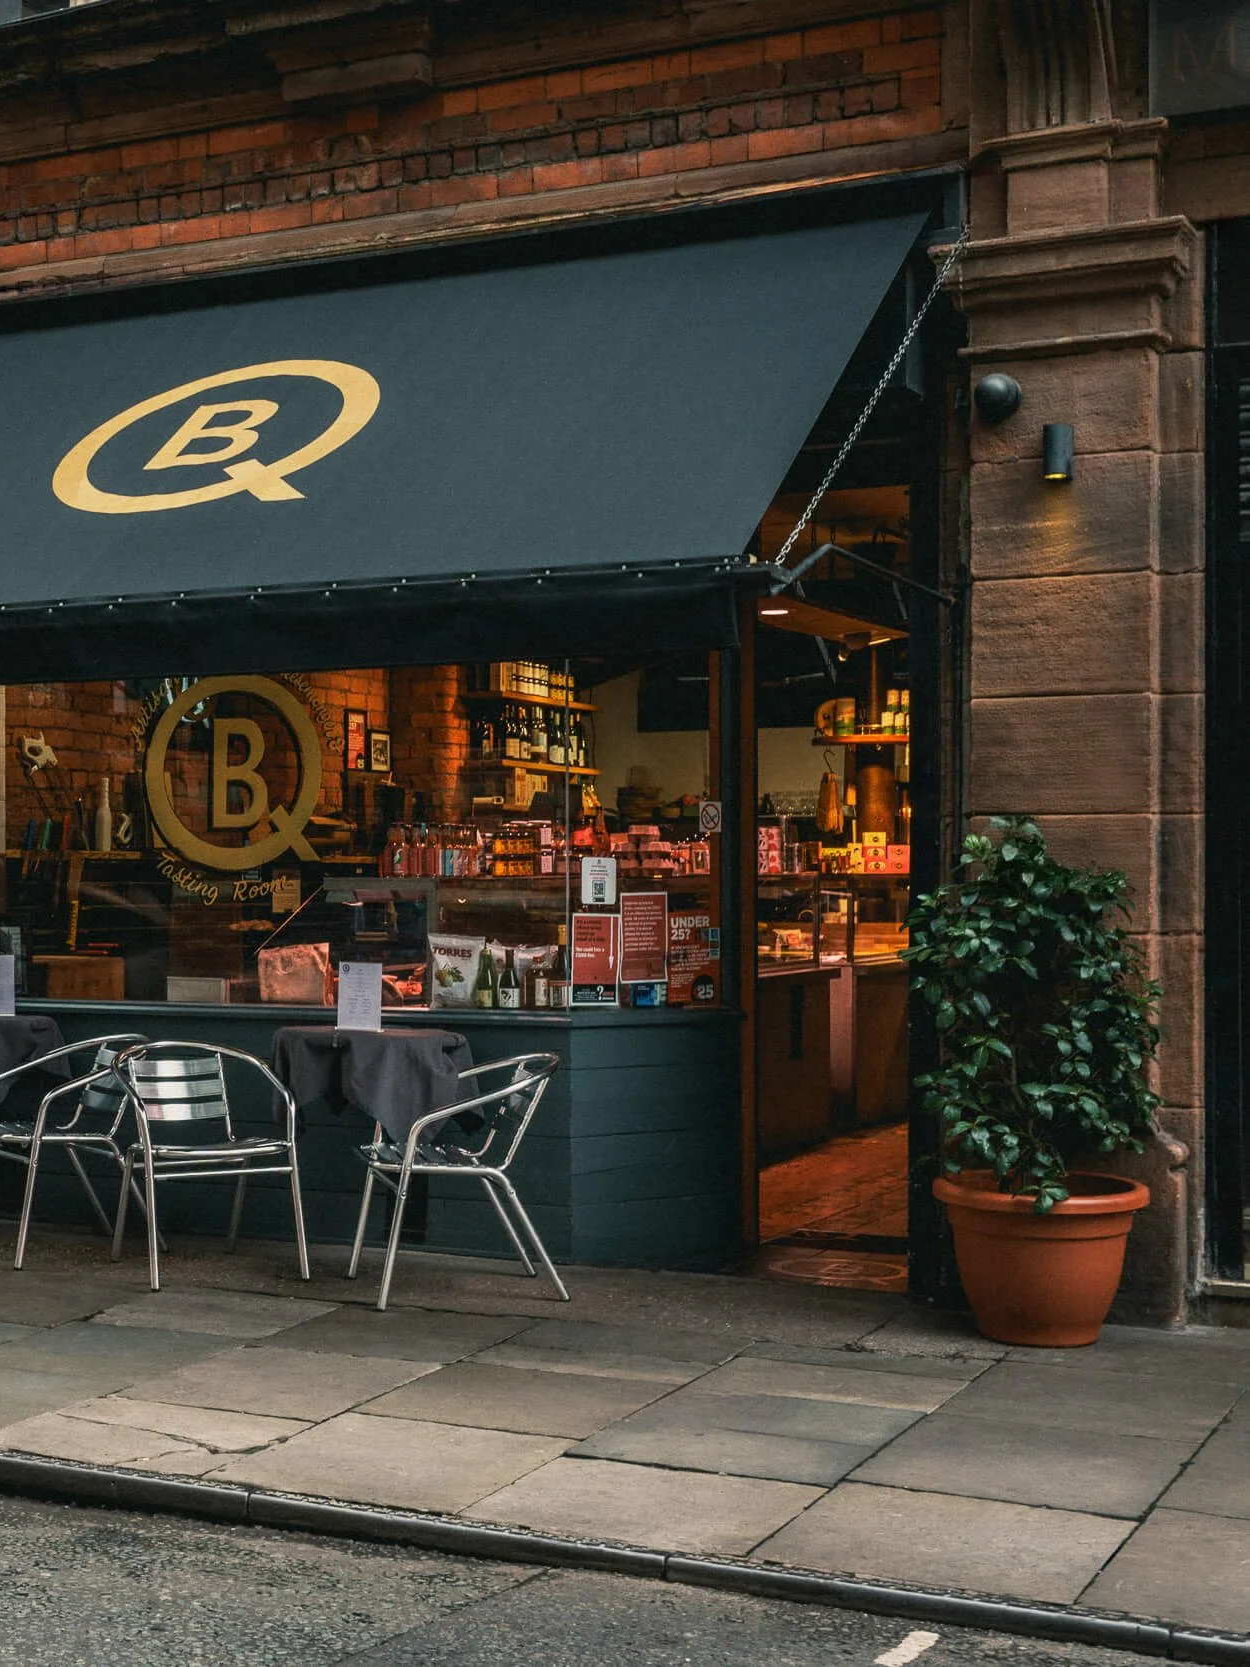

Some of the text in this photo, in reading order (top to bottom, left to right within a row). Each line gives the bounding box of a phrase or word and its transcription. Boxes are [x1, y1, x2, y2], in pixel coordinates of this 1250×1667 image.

[156, 851, 219, 906] Tasting
[232, 876, 288, 902] Room
[670, 916, 710, 929] UNDER
[670, 928, 691, 940] 25?
[432, 947, 472, 957] TORRES
[697, 984, 714, 999] 25
